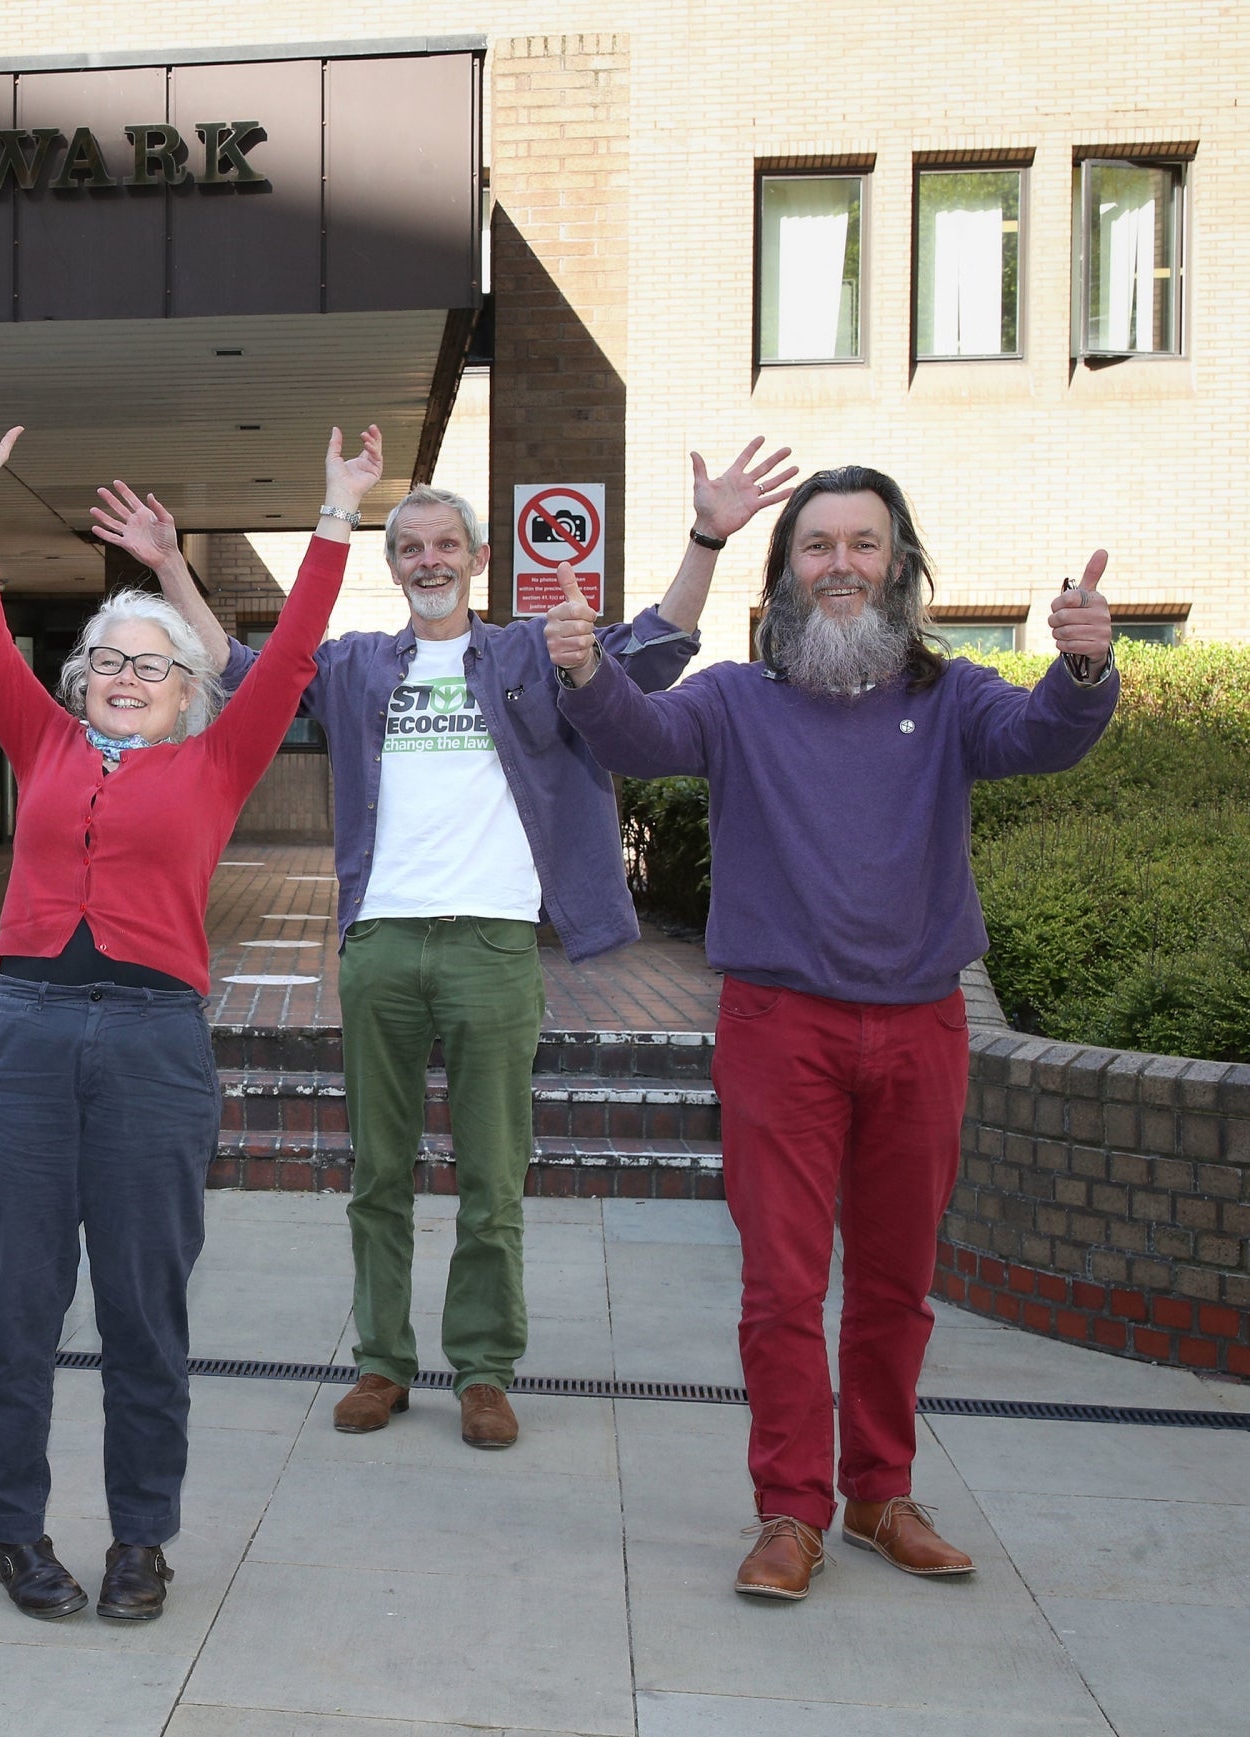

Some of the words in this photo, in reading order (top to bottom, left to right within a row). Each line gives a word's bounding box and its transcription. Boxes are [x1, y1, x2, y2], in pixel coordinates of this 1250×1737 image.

[387, 714, 488, 735] ECOCIDE
[384, 738, 434, 753] change
[437, 737, 461, 750] the
[464, 736, 490, 750] law
